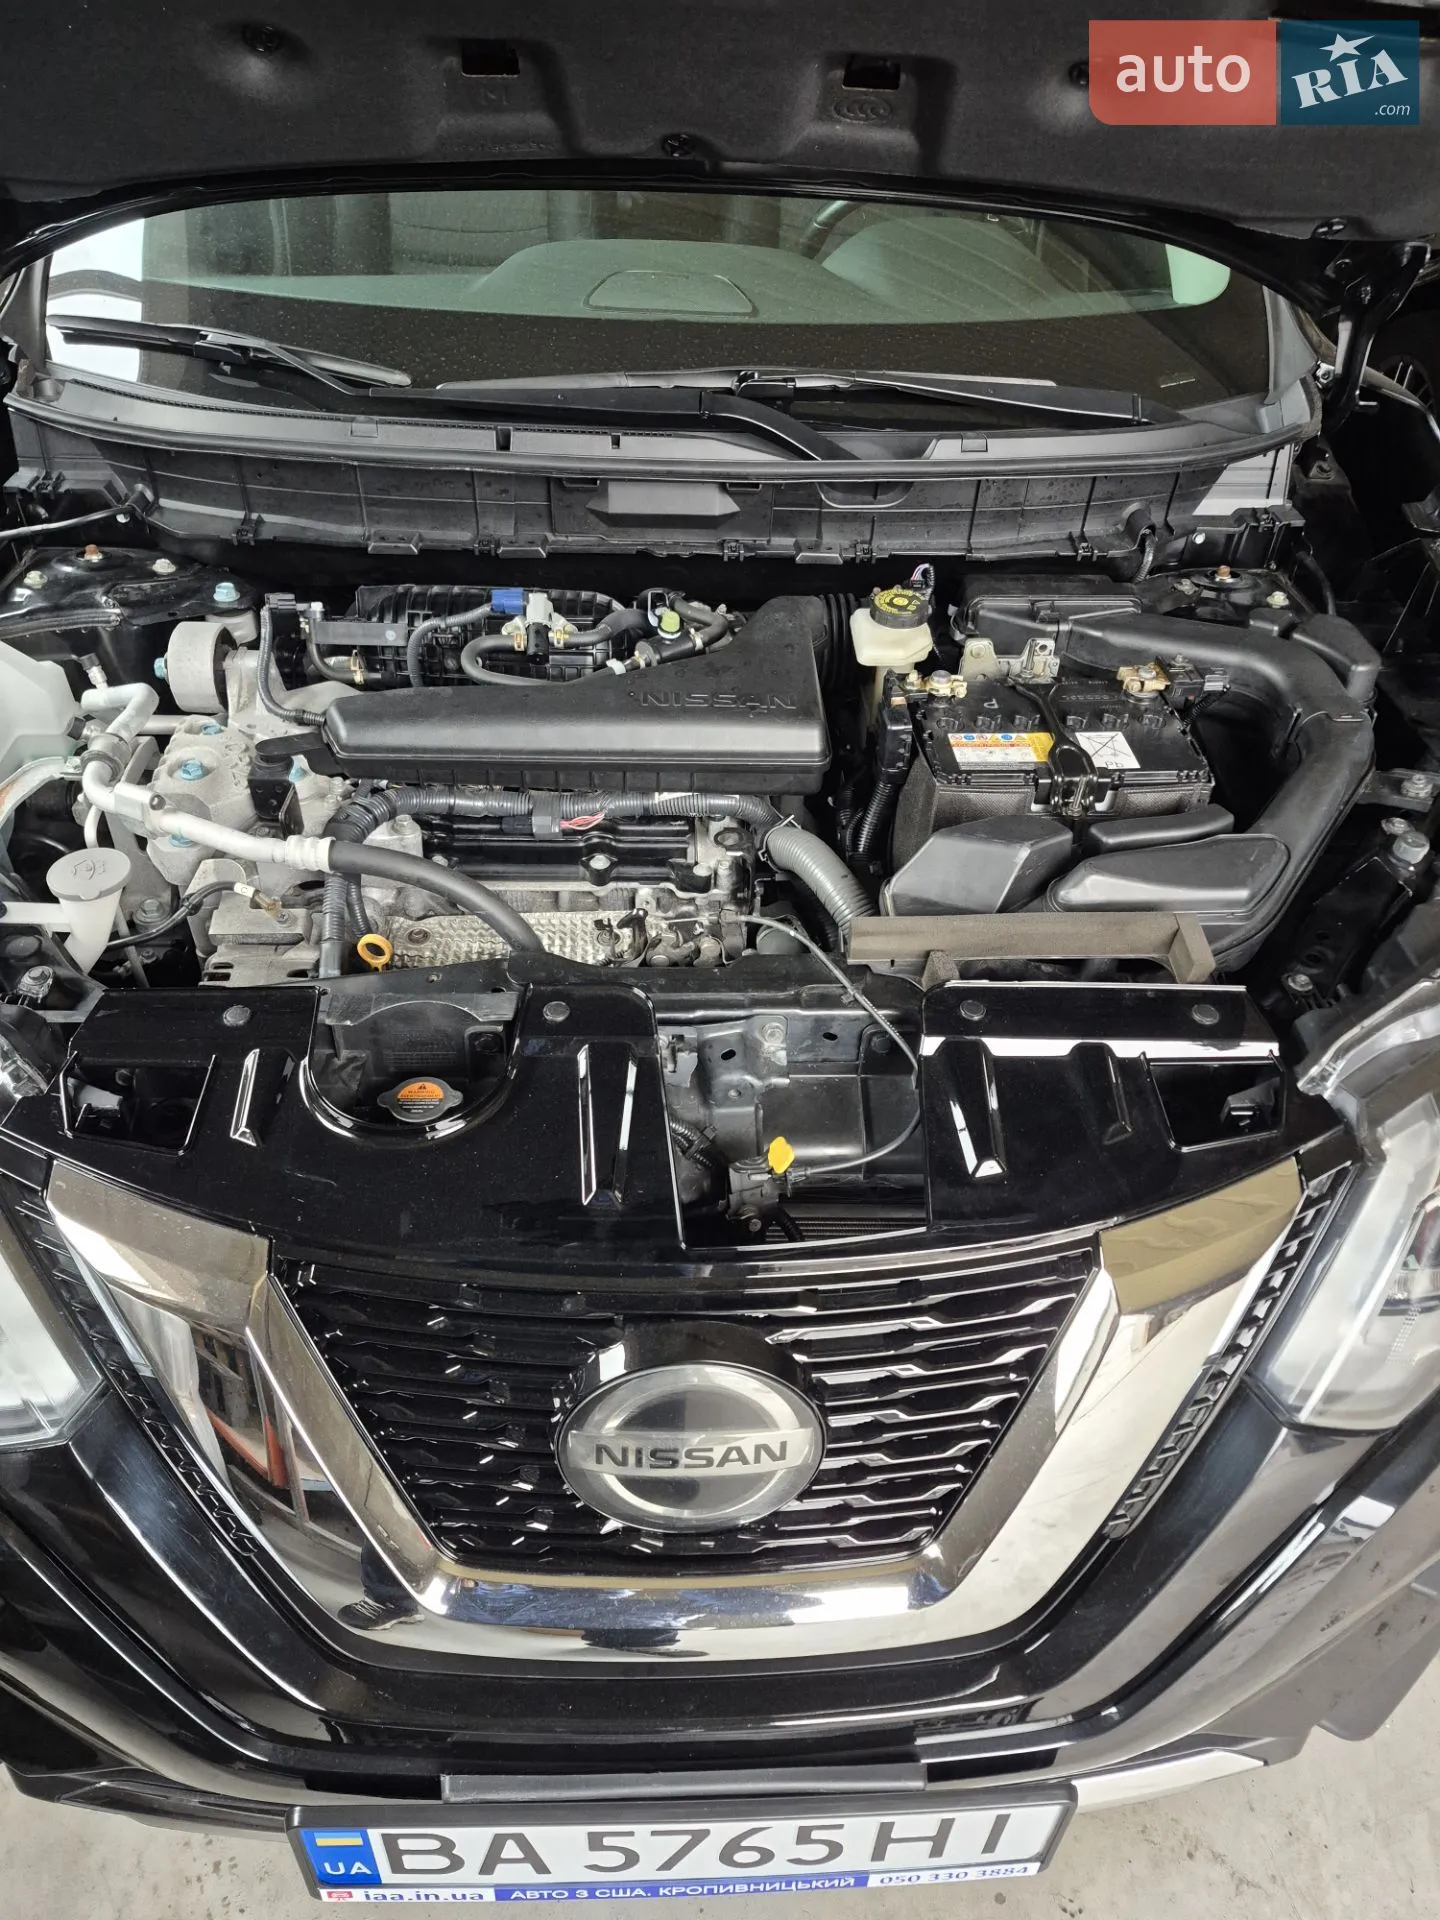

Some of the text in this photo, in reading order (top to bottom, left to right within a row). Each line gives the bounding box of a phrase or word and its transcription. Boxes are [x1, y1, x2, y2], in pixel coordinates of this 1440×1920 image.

[640, 692, 798, 710] NISSAN
[1104, 761, 1125, 769] Pb
[595, 1440, 788, 1470] NISSAN
[381, 1814, 1011, 1876] BA 5765 HI
[323, 1861, 372, 1875] UA
[879, 1866, 1029, 1885] 050 330 3884
[364, 1890, 484, 1901] iaa.in.ua
[510, 1890, 569, 1900] АВТО
[595, 1887, 651, 1897] США.
[659, 1877, 855, 1896] КРОПИВНИЦЬКИЙ
